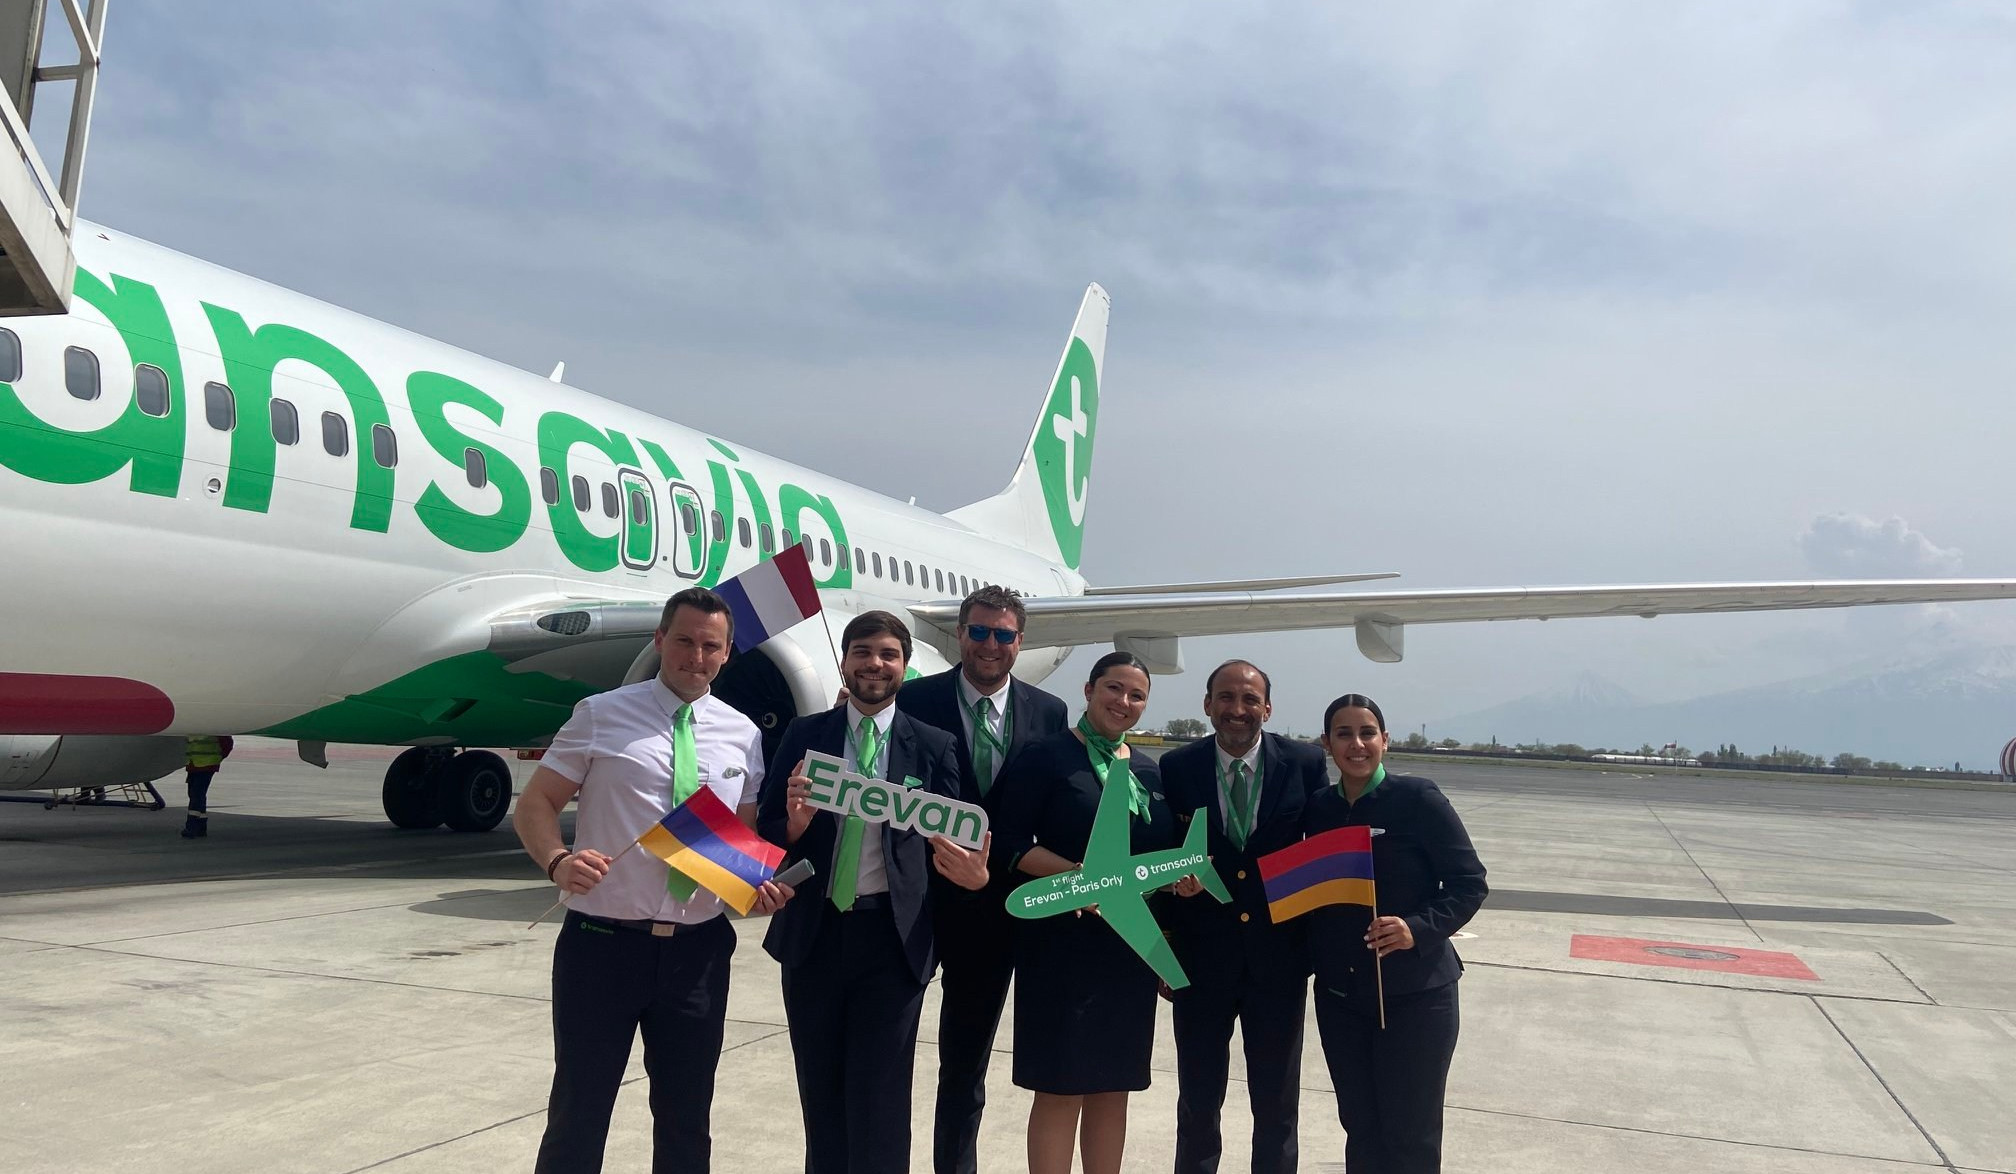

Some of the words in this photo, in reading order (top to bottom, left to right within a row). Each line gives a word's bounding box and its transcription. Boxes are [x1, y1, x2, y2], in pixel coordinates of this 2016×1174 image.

[804, 759, 982, 842] Erevan
[1150, 854, 1204, 874] transavia
[1024, 891, 1064, 908] Erevan
[1072, 880, 1100, 896] Paris
[1100, 874, 1123, 887] Orly
[1051, 878, 1061, 888] 1st
[1062, 873, 1084, 886] flight
